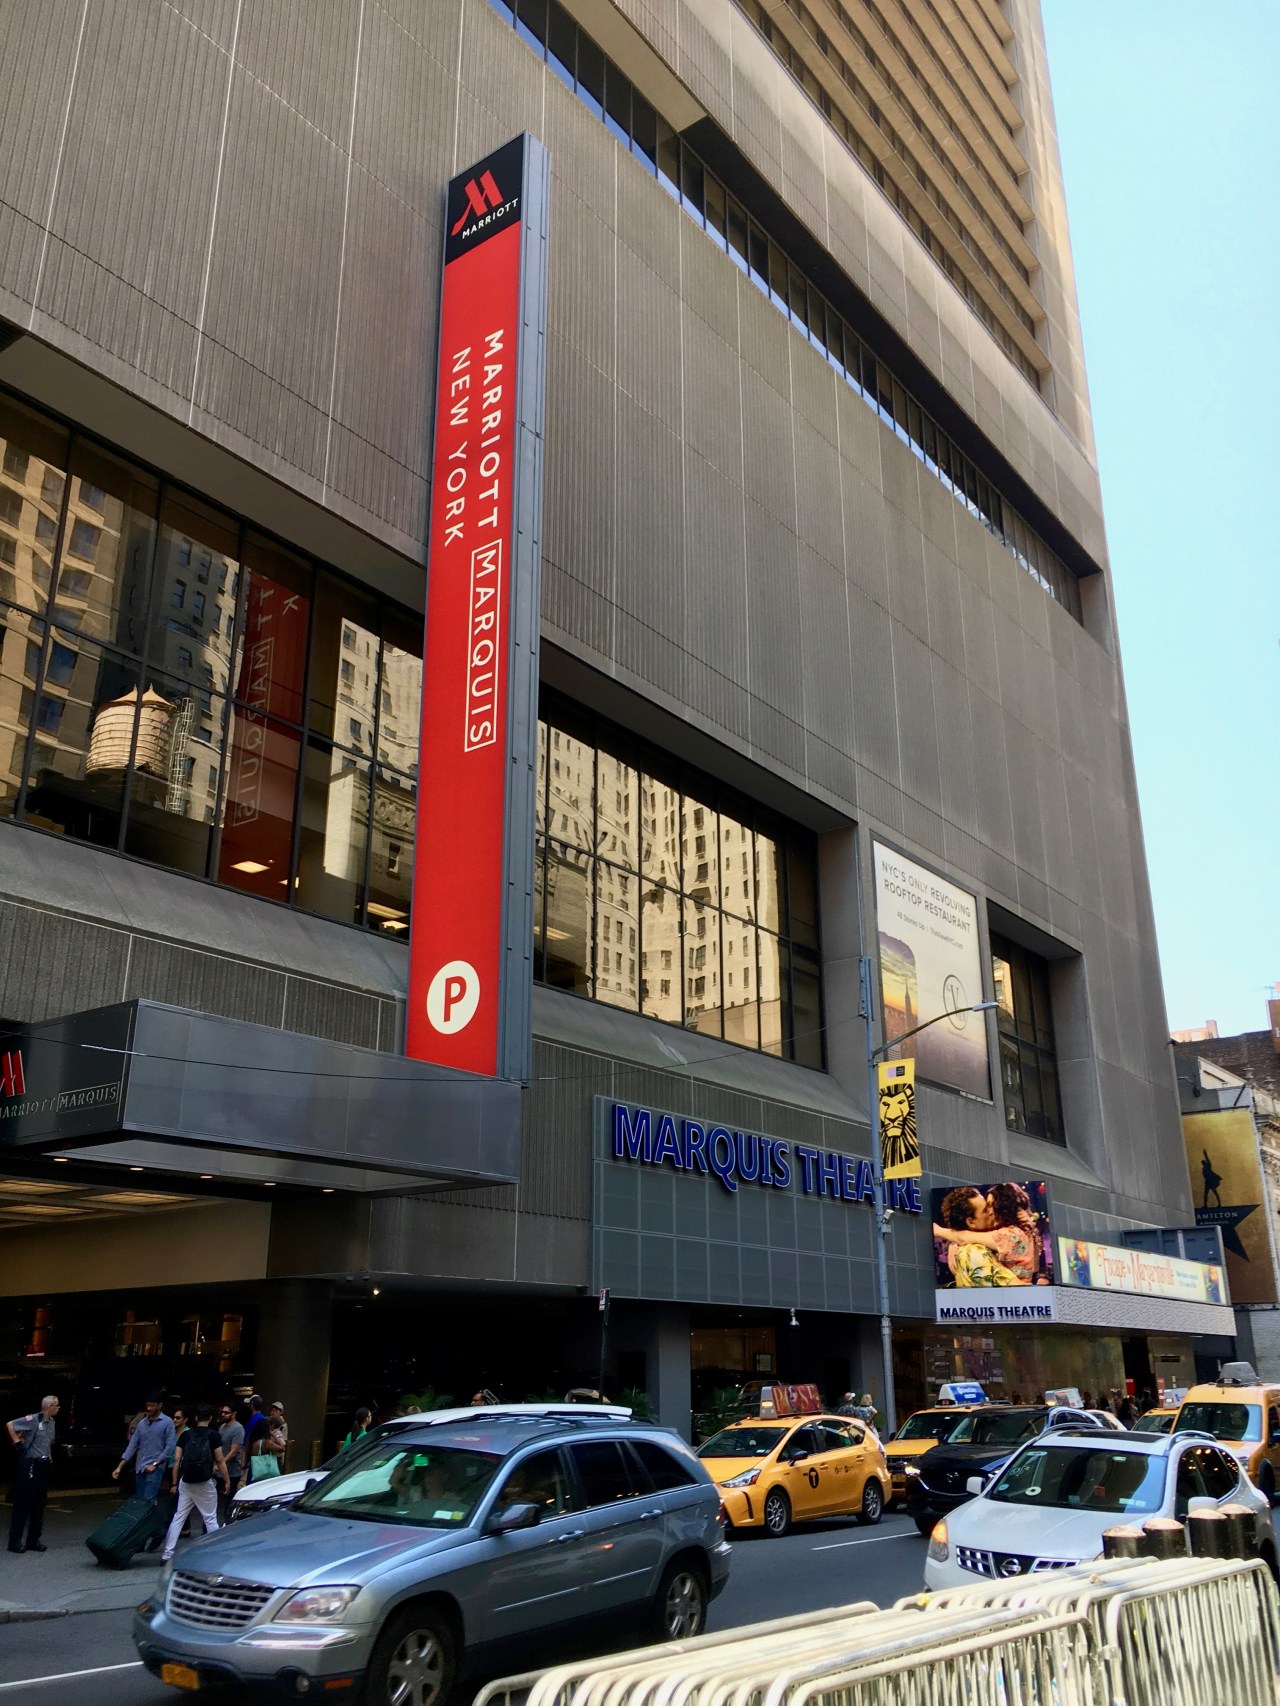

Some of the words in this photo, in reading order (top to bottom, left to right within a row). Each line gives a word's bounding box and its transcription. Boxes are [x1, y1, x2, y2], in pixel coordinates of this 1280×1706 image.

[462, 198, 519, 239] MARRIOTT
[450, 347, 471, 426] NEW
[477, 329, 504, 528] MARRIOTT
[444, 440, 468, 548] YORK
[469, 549, 497, 743] MARQUIS
[881, 861, 906, 882] NYC'S
[908, 875, 928, 894] ONLY
[930, 887, 971, 918] REVOLVING
[884, 879, 922, 907] ROOFTOP
[924, 900, 971, 933] RESTAURANT
[443, 975, 467, 1023] P
[59, 1086, 117, 1108] MARQUIS
[611, 1103, 792, 1192] MARQUIS
[1196, 1211, 1238, 1220] AMILTON
[940, 1307, 995, 1319] MARQUIS
[997, 1305, 1052, 1317] THEATRE
